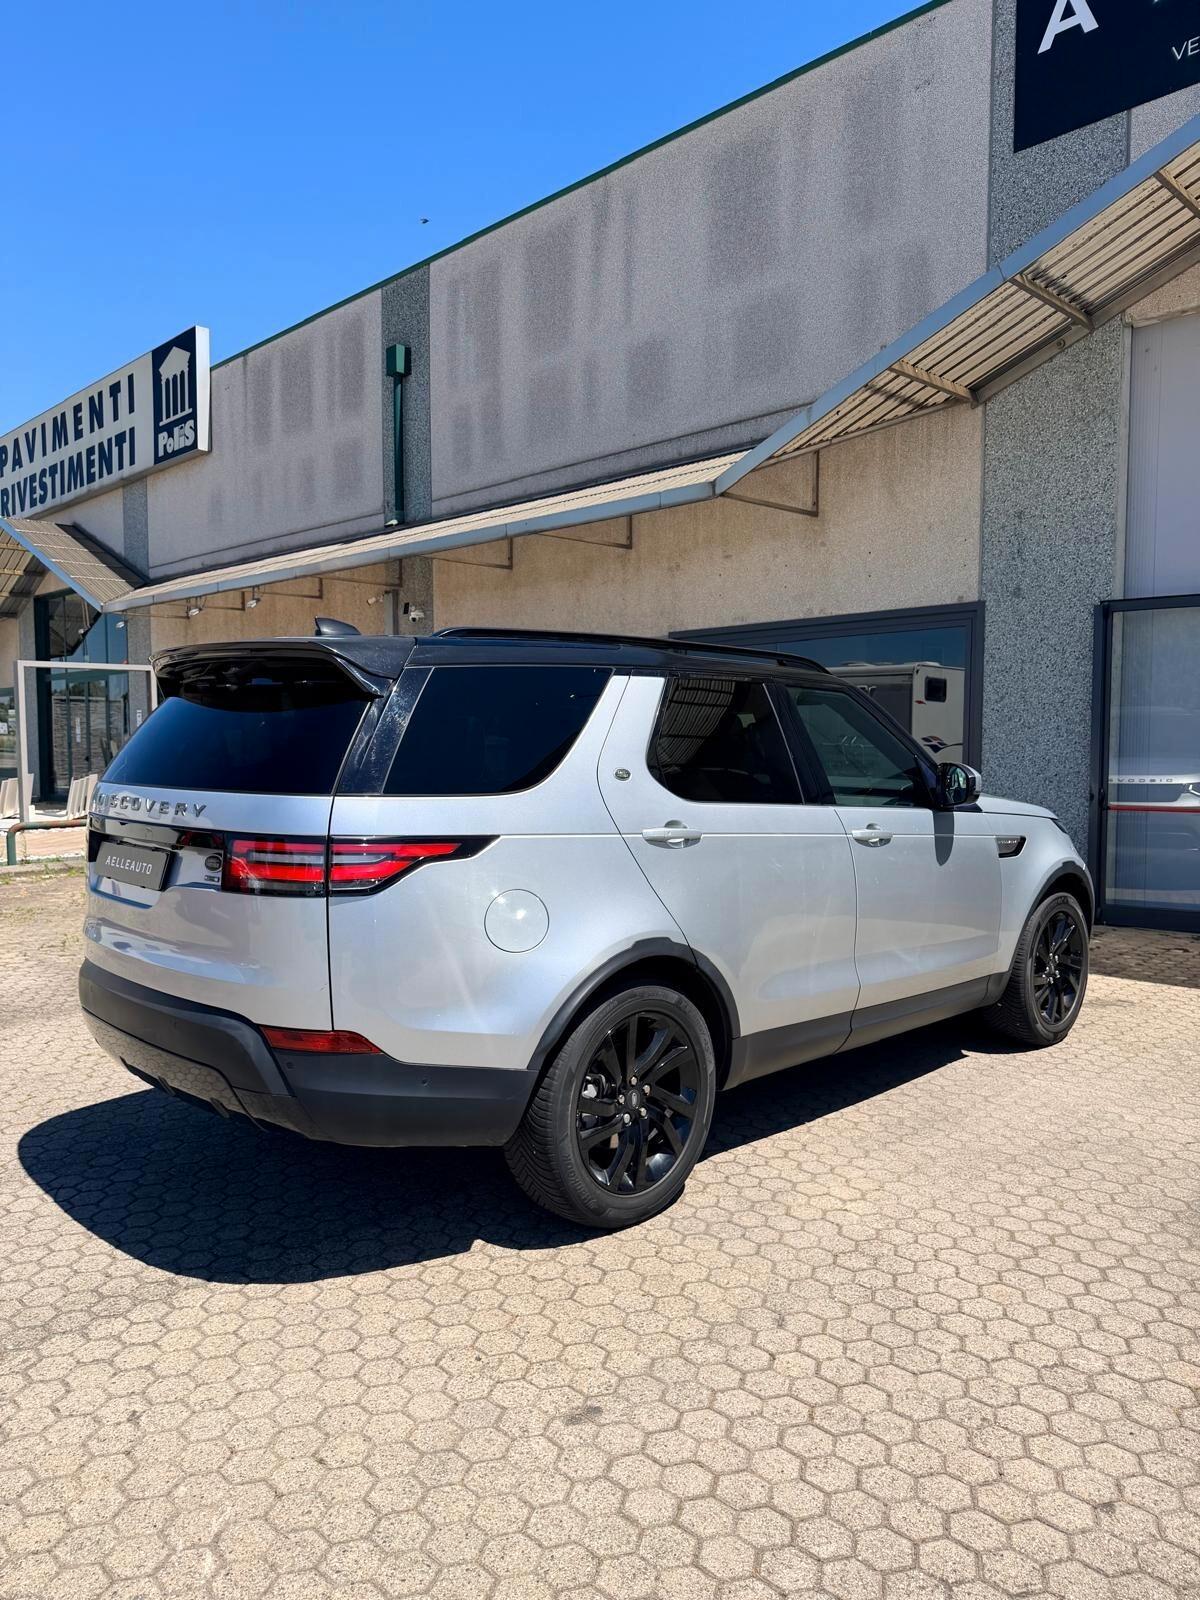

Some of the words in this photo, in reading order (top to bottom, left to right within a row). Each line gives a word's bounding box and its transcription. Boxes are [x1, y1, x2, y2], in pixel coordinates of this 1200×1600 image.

[0, 373, 135, 478] PAVIMENTI
[0, 427, 136, 517] RIVESTIMENTI
[105, 855, 153, 875] AELLEAUTO
